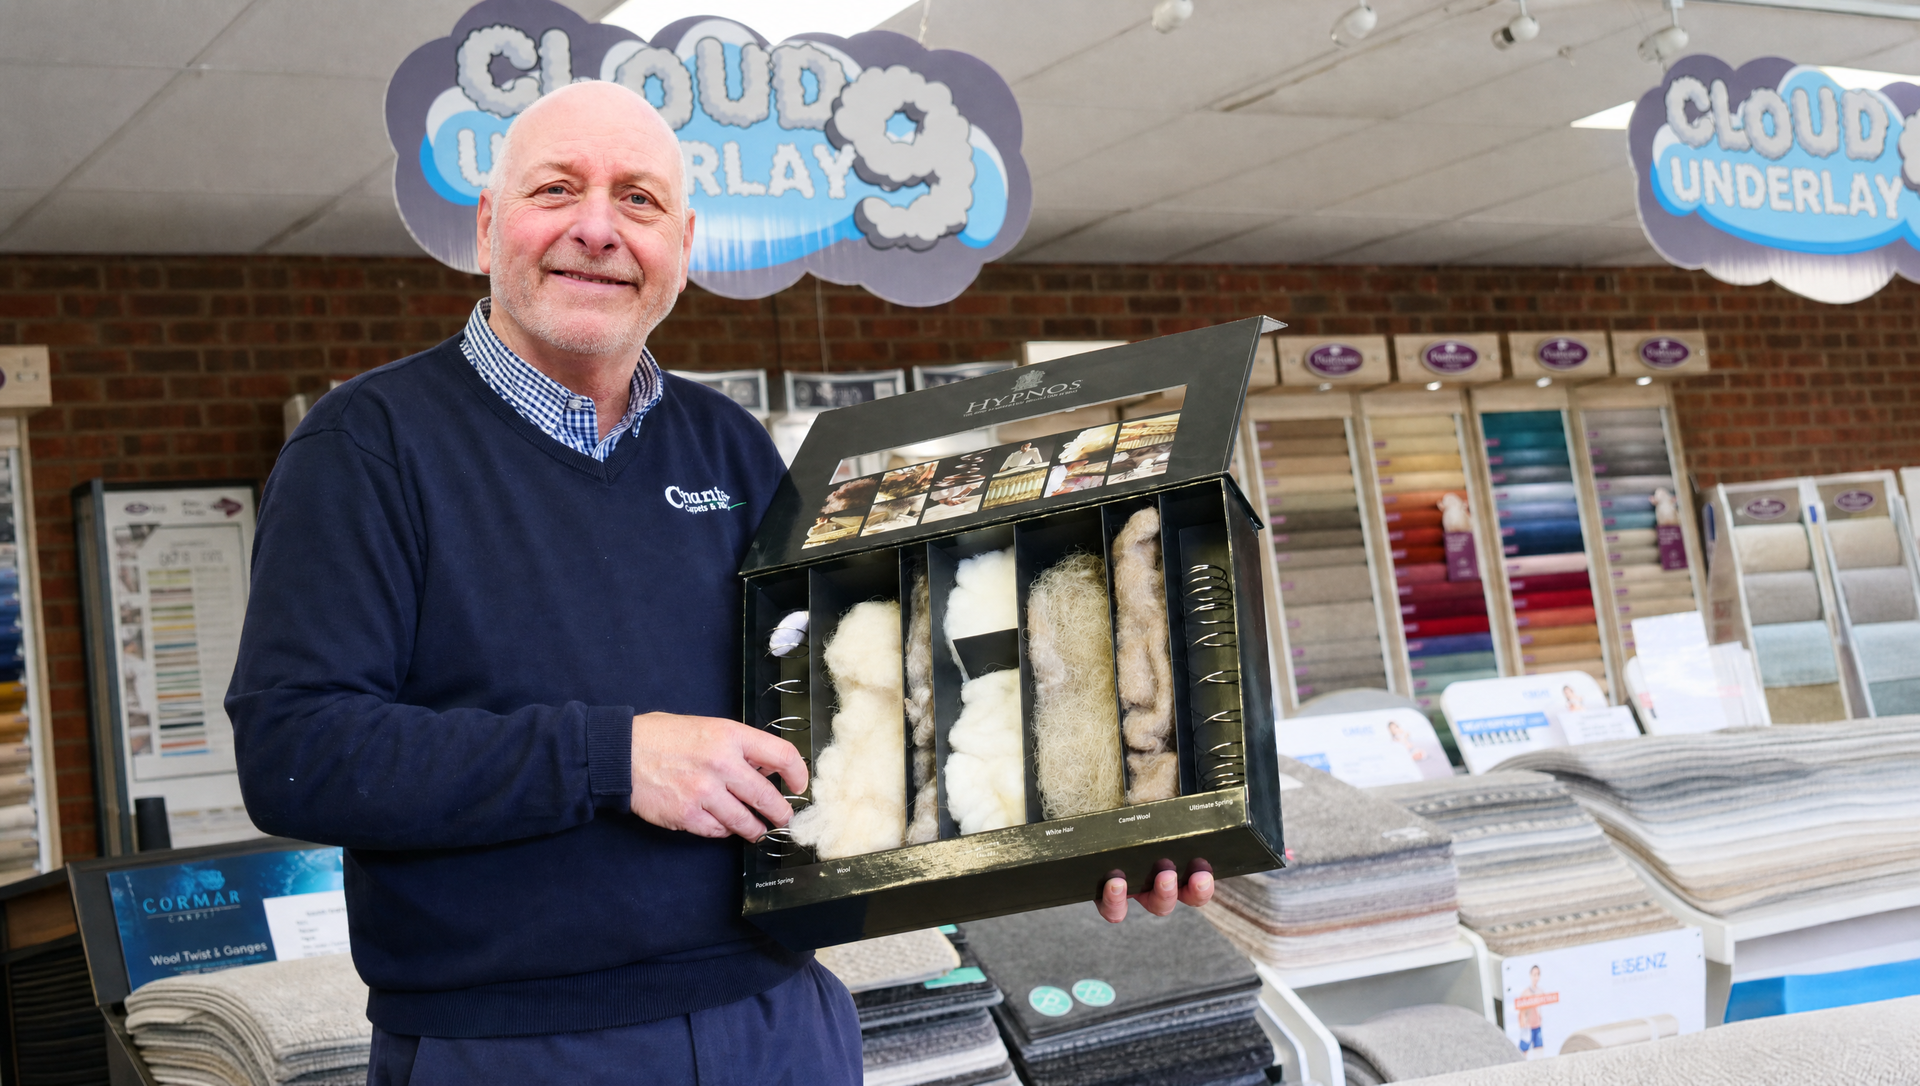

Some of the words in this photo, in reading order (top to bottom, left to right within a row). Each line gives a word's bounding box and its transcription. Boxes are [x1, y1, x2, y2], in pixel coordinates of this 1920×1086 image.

[1666, 75, 1889, 161] CLOUD
[457, 128, 856, 199] URLAY
[826, 65, 976, 251] 9
[1670, 156, 1903, 220] UNDERLAY
[965, 379, 1082, 413] HYPNOS
[1189, 802, 1214, 811] Ultimate
[1214, 798, 1234, 808] Spring
[1118, 815, 1136, 824] Camel
[1136, 812, 1151, 821] Wool
[1045, 828, 1062, 837] White
[1063, 825, 1075, 834] Hair
[777, 876, 795, 886] Spring
[836, 866, 851, 874] Wool
[143, 889, 241, 914] CORMAR
[150, 953, 181, 967] Wool
[181, 948, 211, 963] Twist
[213, 946, 221, 958] &
[223, 941, 268, 957] Ganges
